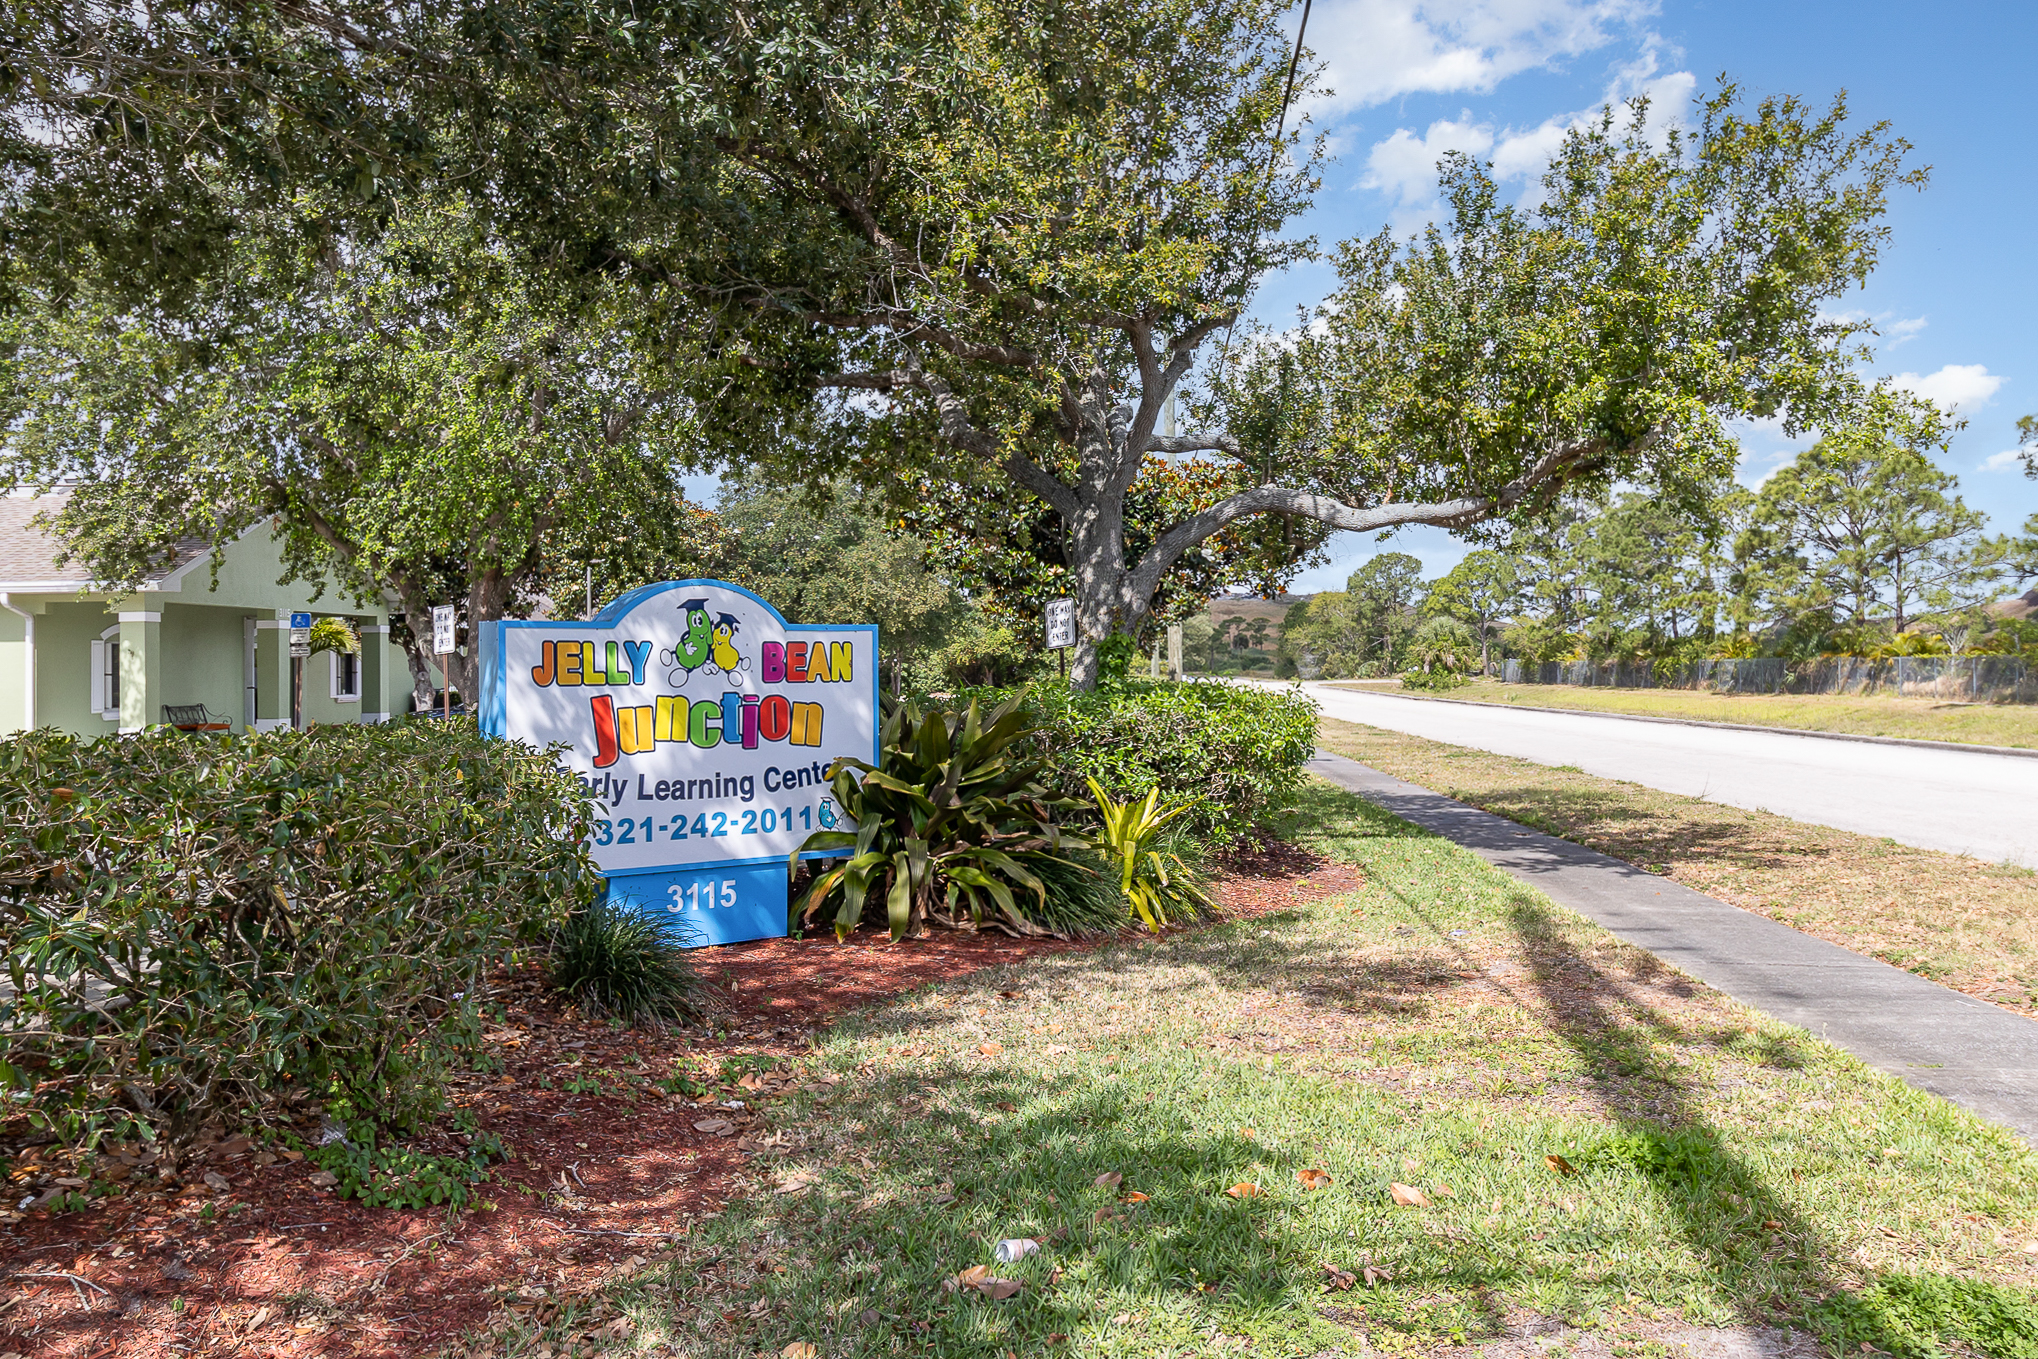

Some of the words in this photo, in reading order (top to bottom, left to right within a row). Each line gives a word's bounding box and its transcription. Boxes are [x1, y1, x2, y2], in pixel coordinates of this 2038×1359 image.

[1047, 606, 1059, 617] ONE
[1050, 619, 1058, 630] DO
[1059, 617, 1070, 628] NOT
[1052, 631, 1069, 642] ENTER
[531, 640, 653, 687] JELLY
[762, 641, 853, 684] BEAN
[590, 691, 824, 768] Junction
[555, 768, 628, 807] arly
[637, 772, 754, 803] Learning
[764, 761, 835, 793] Cente
[595, 805, 811, 847] 321-242-2011
[666, 879, 737, 913] 3115
